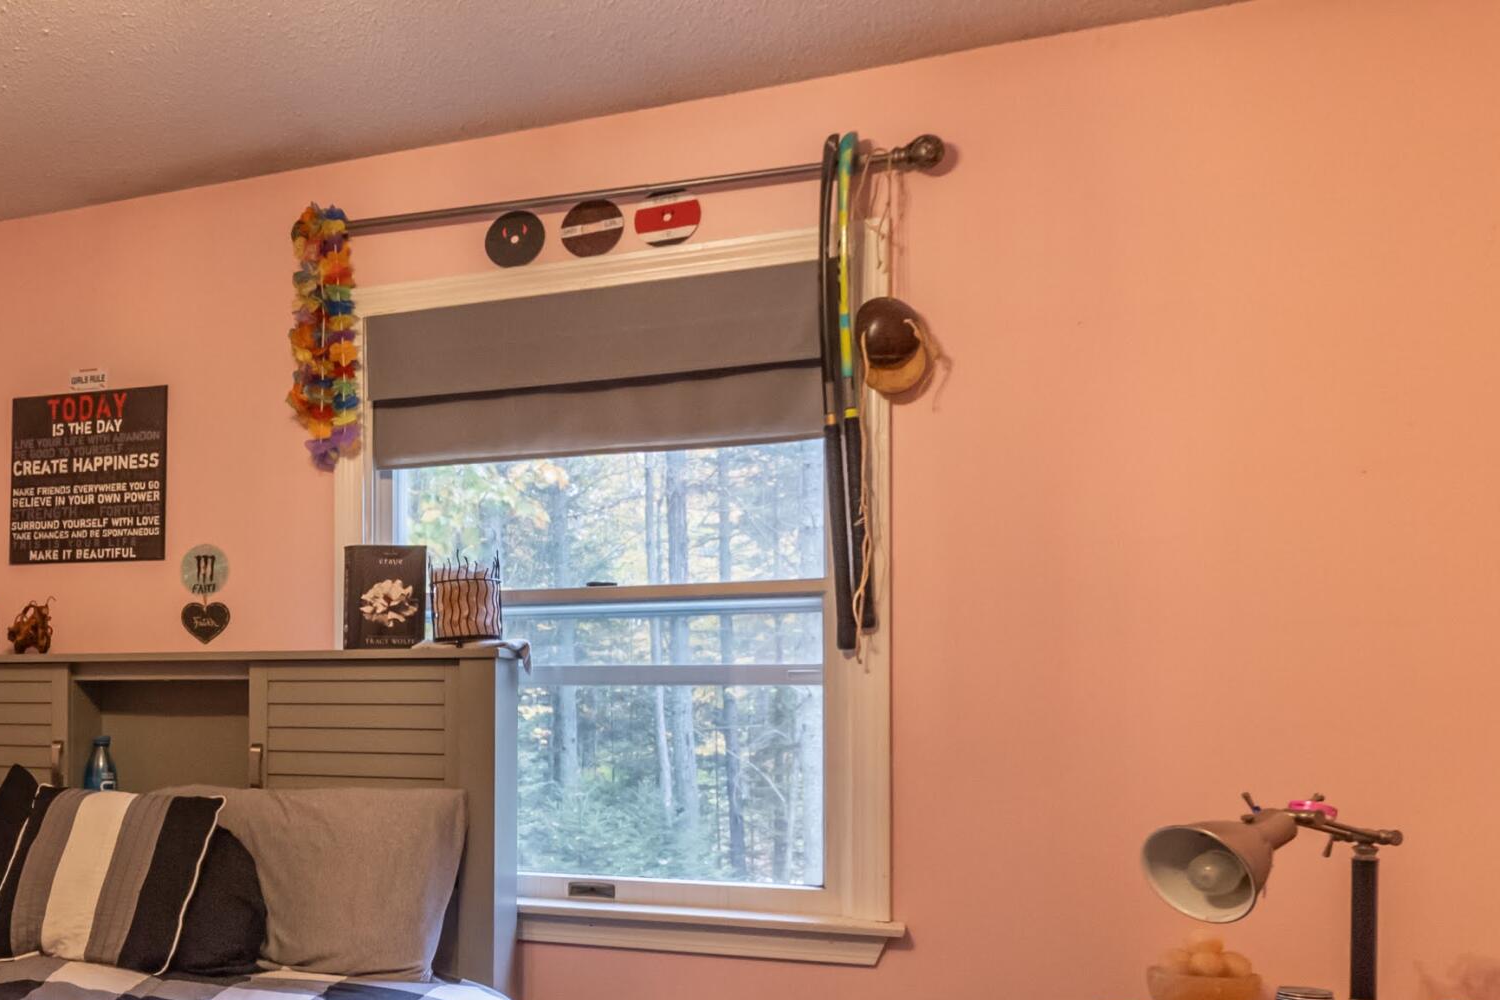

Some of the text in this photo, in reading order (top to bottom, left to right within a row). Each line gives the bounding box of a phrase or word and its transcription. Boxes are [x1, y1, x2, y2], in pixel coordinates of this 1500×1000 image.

[47, 392, 127, 421] TODAY
[52, 419, 122, 437] IS THE DAY
[112, 431, 160, 443] ABANDON
[13, 453, 160, 476] CREATE HAPPINESS
[12, 481, 160, 497] MAKE FRIENDS EVERYWHERE YOU GO
[12, 491, 160, 508] BELIEVE IN YOUR OWN POWER
[12, 507, 78, 520] STRENGTH
[100, 503, 160, 517] FORTITUDE
[11, 515, 160, 532] SURROUND YOURSELF WITH LOVE
[12, 527, 160, 540] TAKE CHANCES AND BE SPONTANEOUS
[29, 547, 136, 561] MAKE IT BEAUTIFUL
